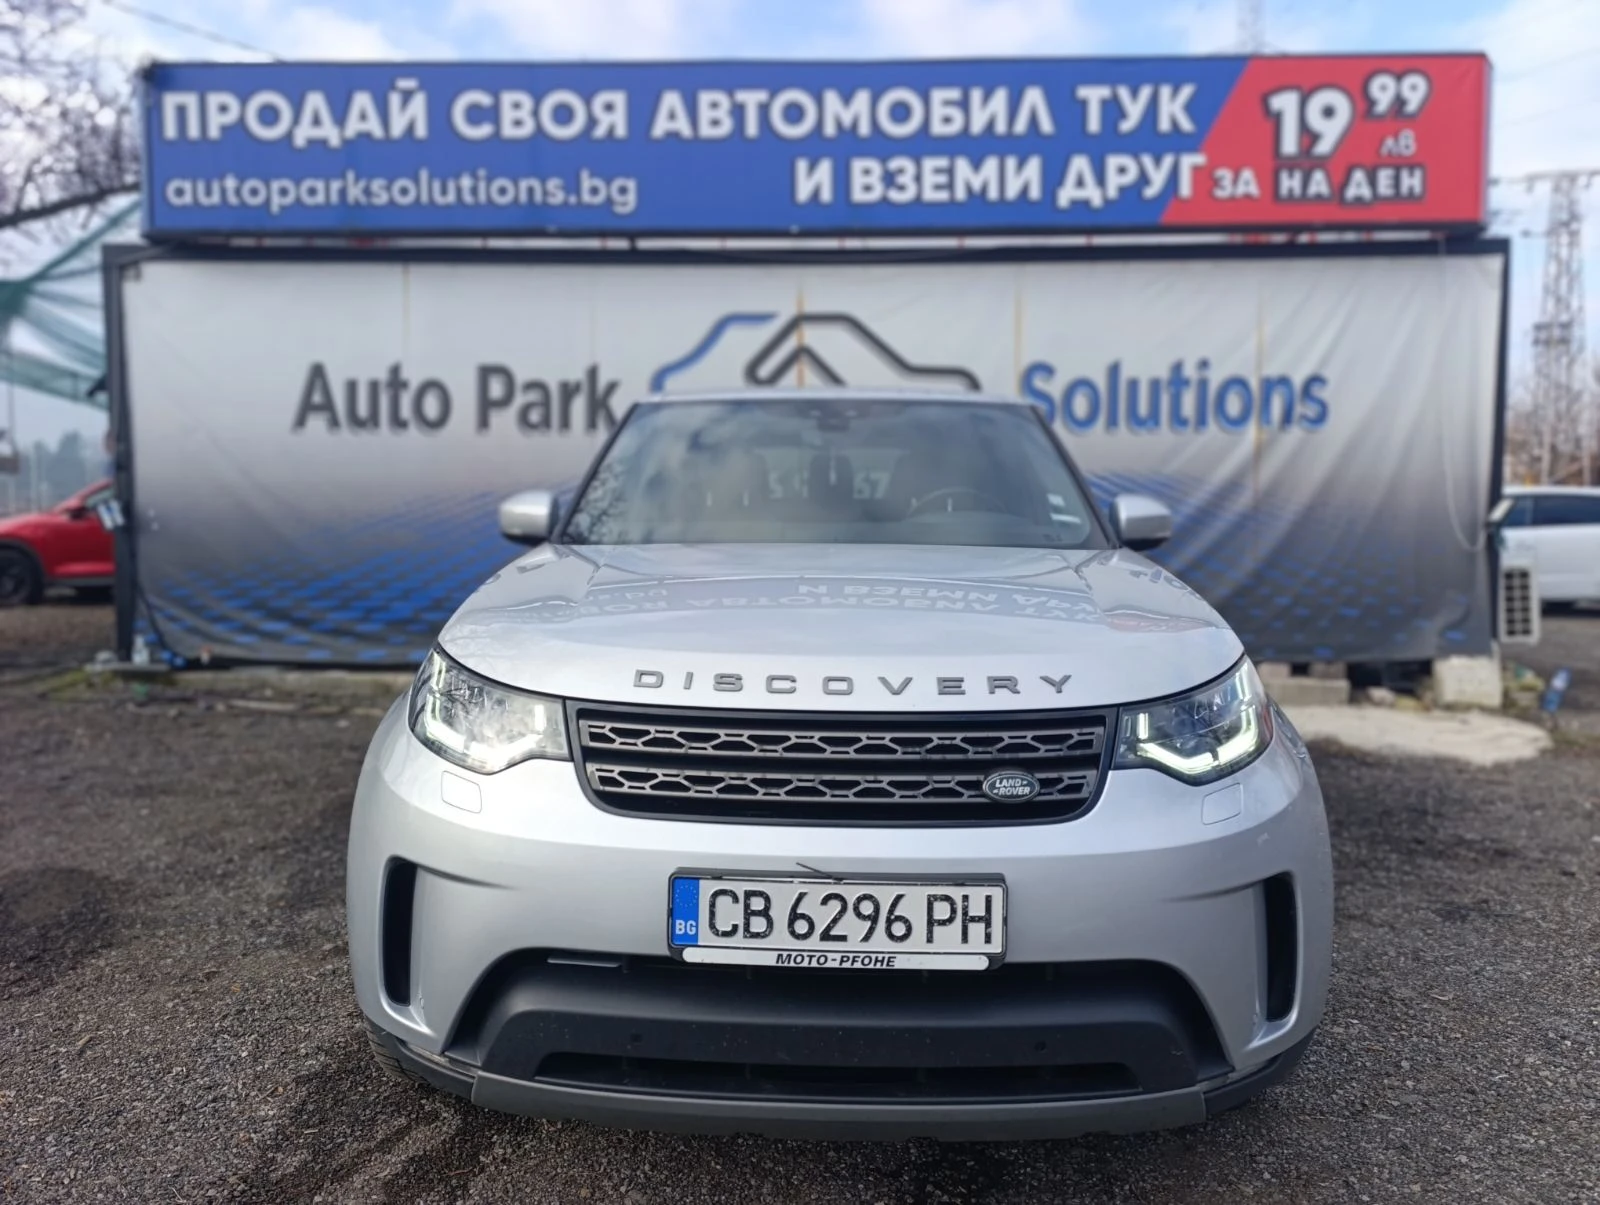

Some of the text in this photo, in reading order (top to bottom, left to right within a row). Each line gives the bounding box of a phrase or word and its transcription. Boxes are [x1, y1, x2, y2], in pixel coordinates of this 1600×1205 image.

[161, 77, 1196, 149] ПРОДАЙ СВОЯ АВТОМОБИЛ ТУК
[1367, 71, 1429, 116] 99
[1265, 86, 1353, 159] 19
[165, 167, 637, 214] autoparksolutions.bg
[794, 153, 1423, 209] И ВЗЕМИ ДРУГ ЗА НА ДЕН
[292, 358, 1330, 434] Auto Park Solutions
[633, 669, 1073, 696] DISCOVERY
[675, 919, 697, 936] BG
[708, 888, 993, 945] CB 6296 PH
[776, 952, 897, 968] MOTO-PFOHE
